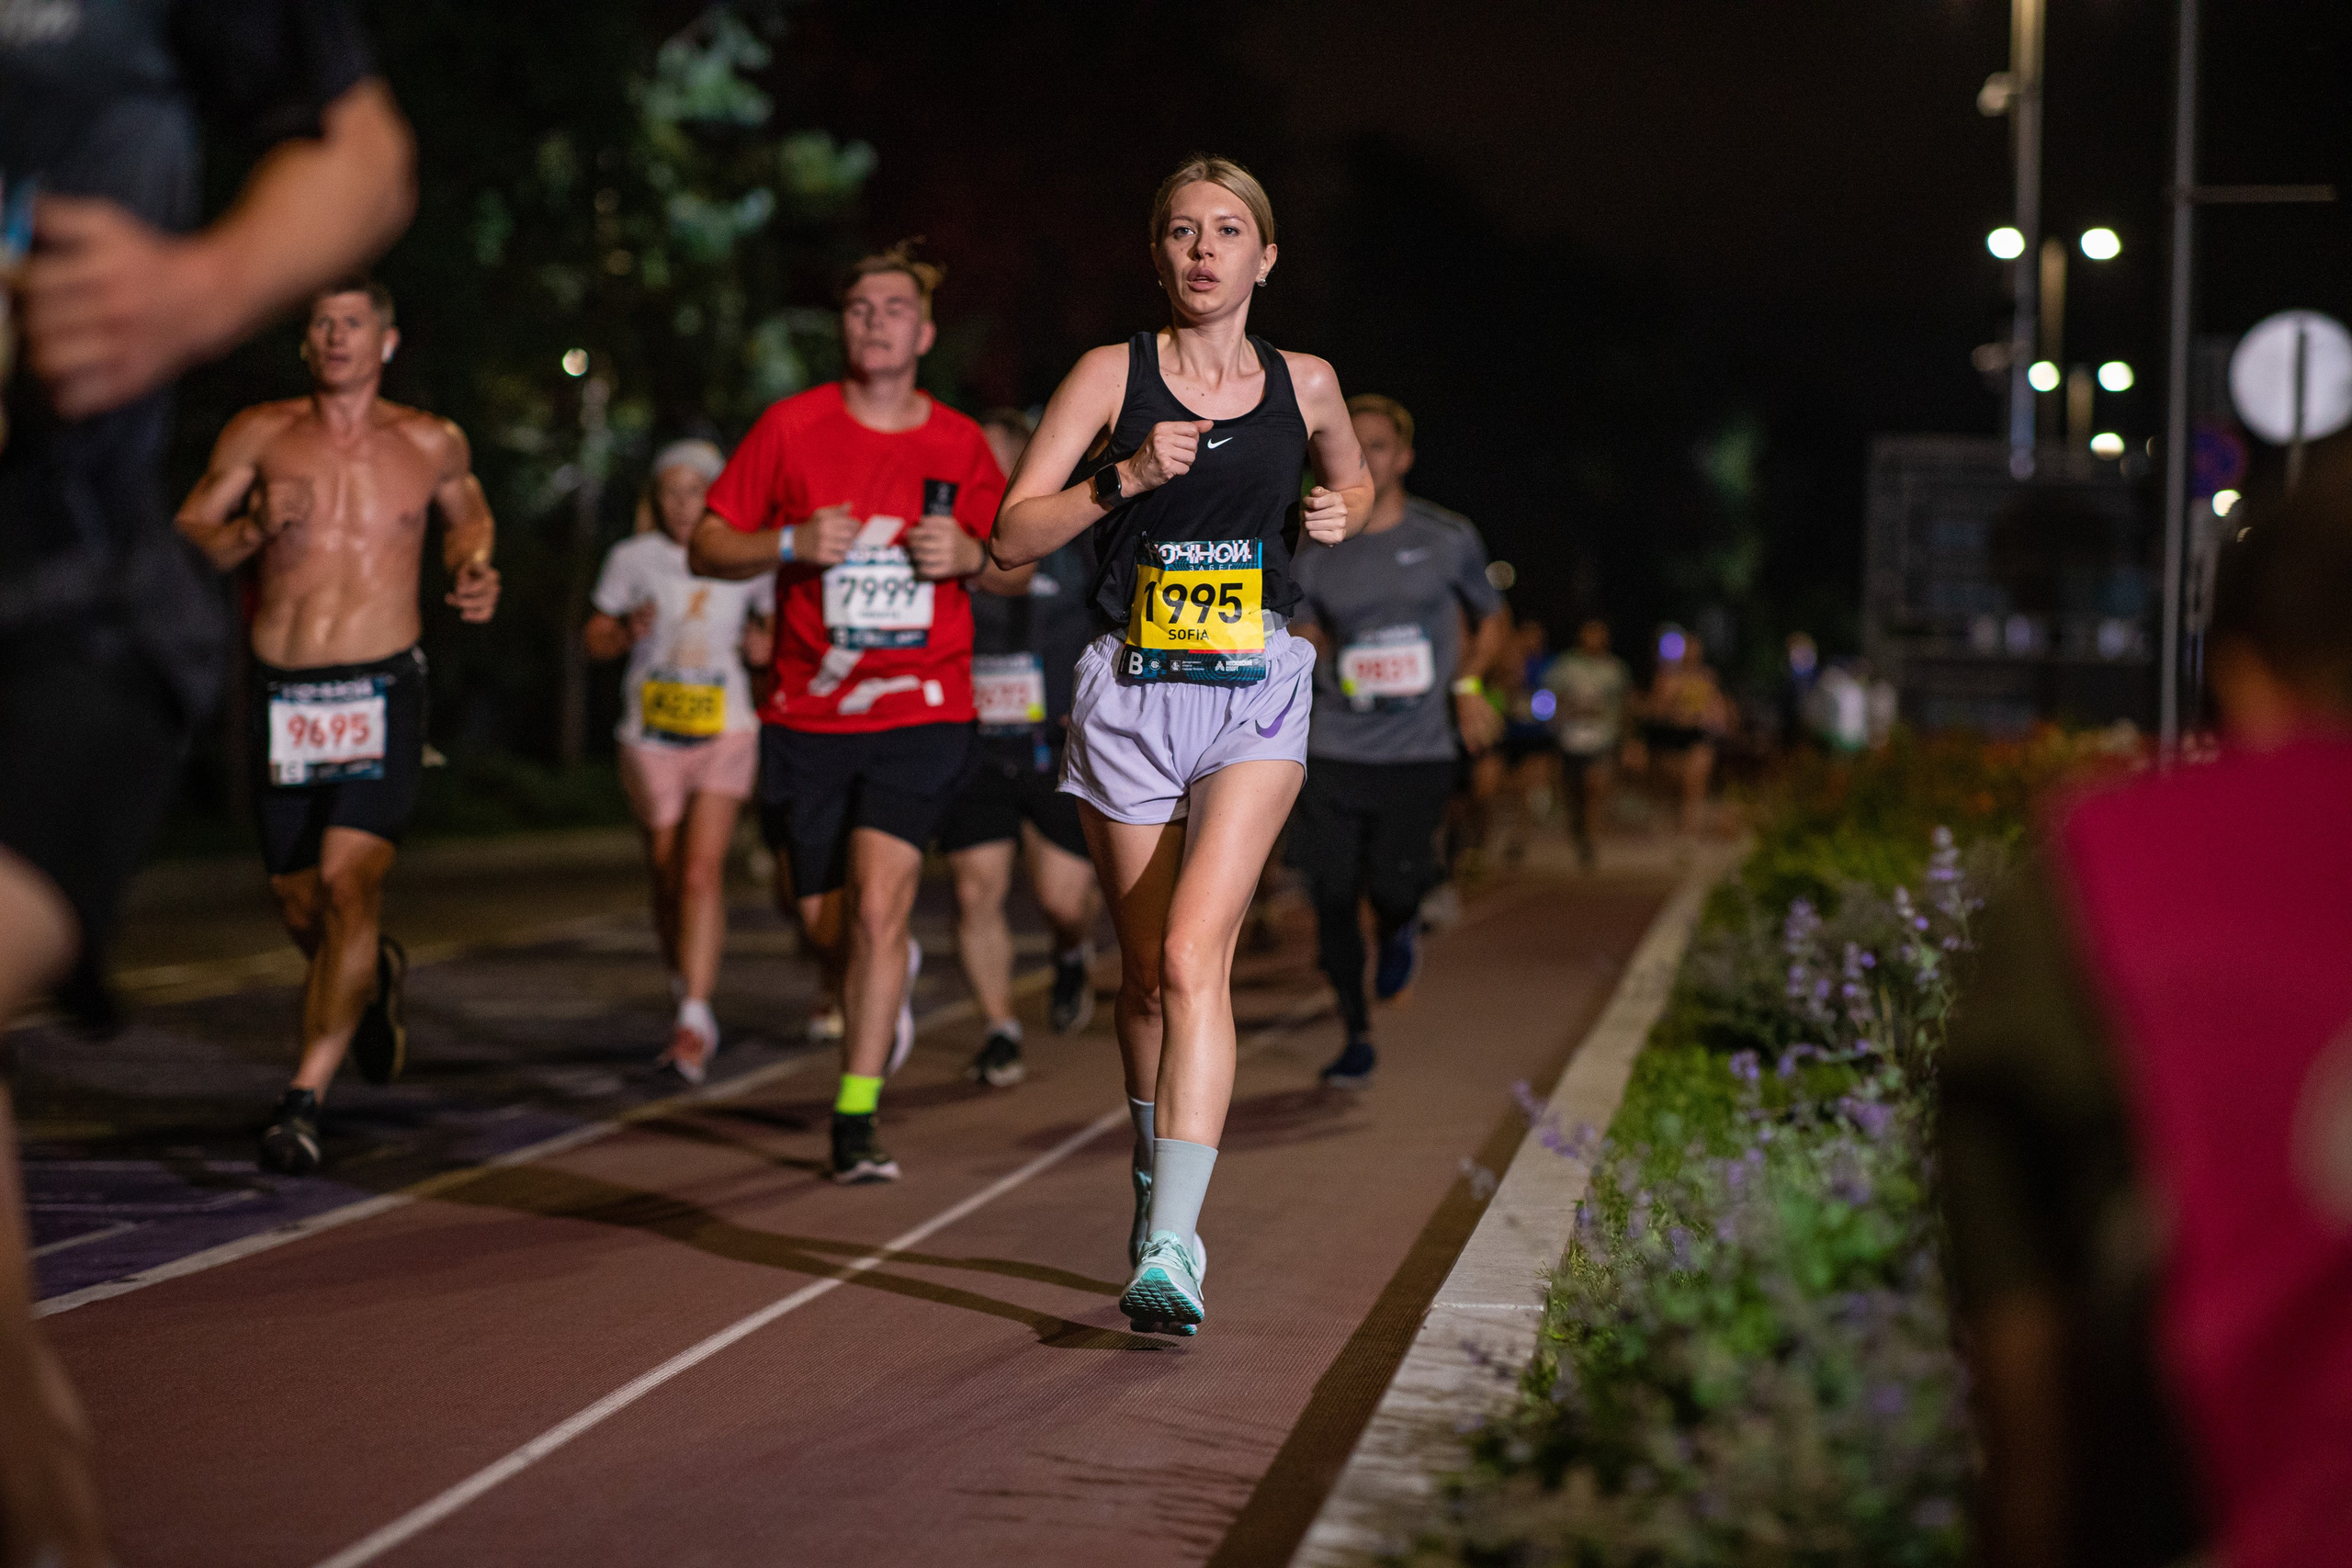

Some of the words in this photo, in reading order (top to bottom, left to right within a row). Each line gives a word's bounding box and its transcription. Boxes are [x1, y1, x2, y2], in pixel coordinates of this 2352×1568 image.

[838, 577, 918, 607] 7999
[1144, 581, 1243, 624] 1995
[1168, 629, 1210, 640] SOFIA
[287, 713, 371, 749] 9695
